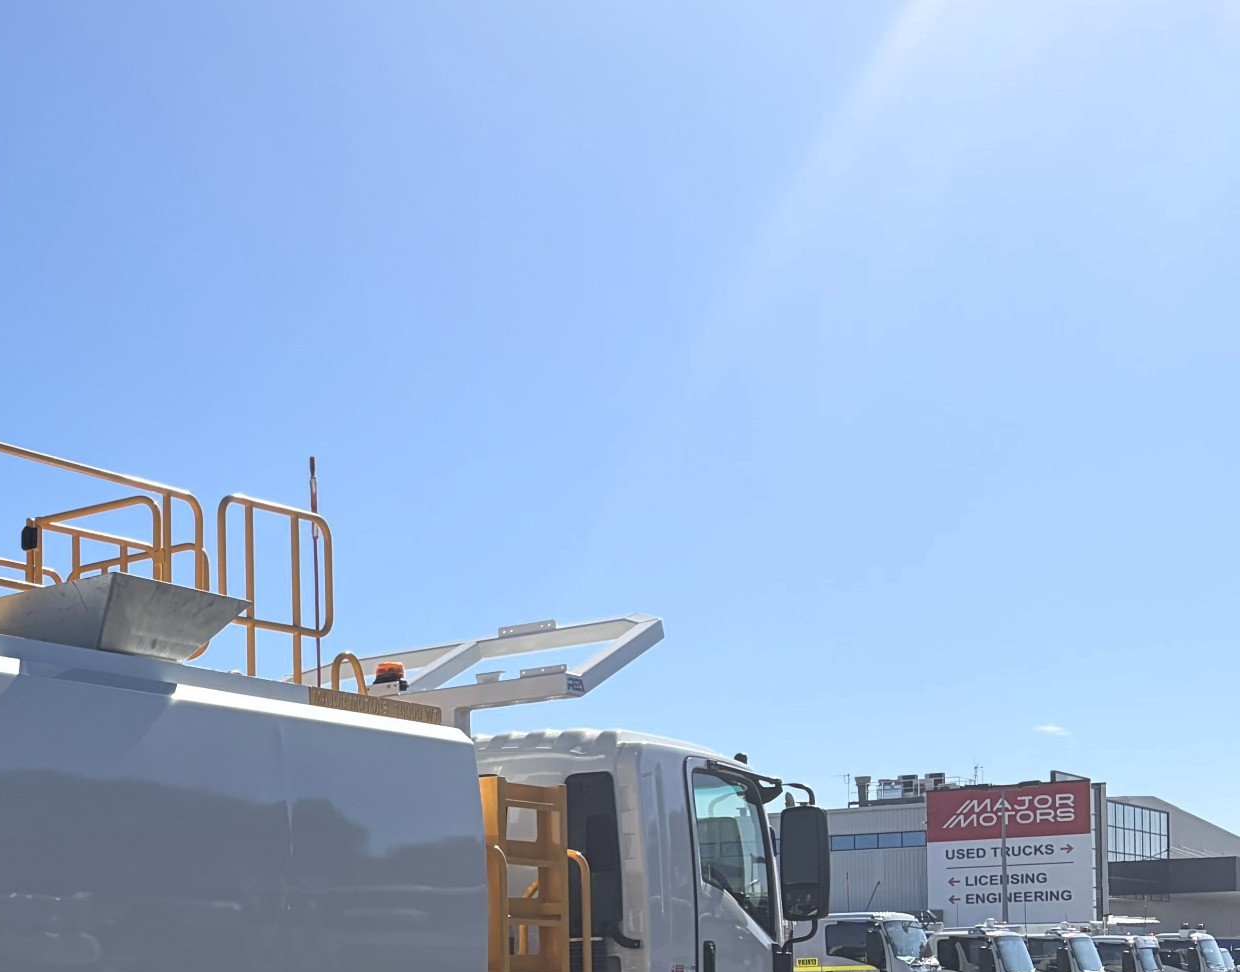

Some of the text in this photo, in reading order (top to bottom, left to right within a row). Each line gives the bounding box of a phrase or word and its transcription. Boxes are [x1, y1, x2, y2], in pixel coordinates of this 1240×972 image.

[956, 793, 1075, 814] MAJOR
[942, 807, 1075, 829] MOTORS
[945, 847, 986, 860] USED
[991, 844, 1055, 858] TRUCKS
